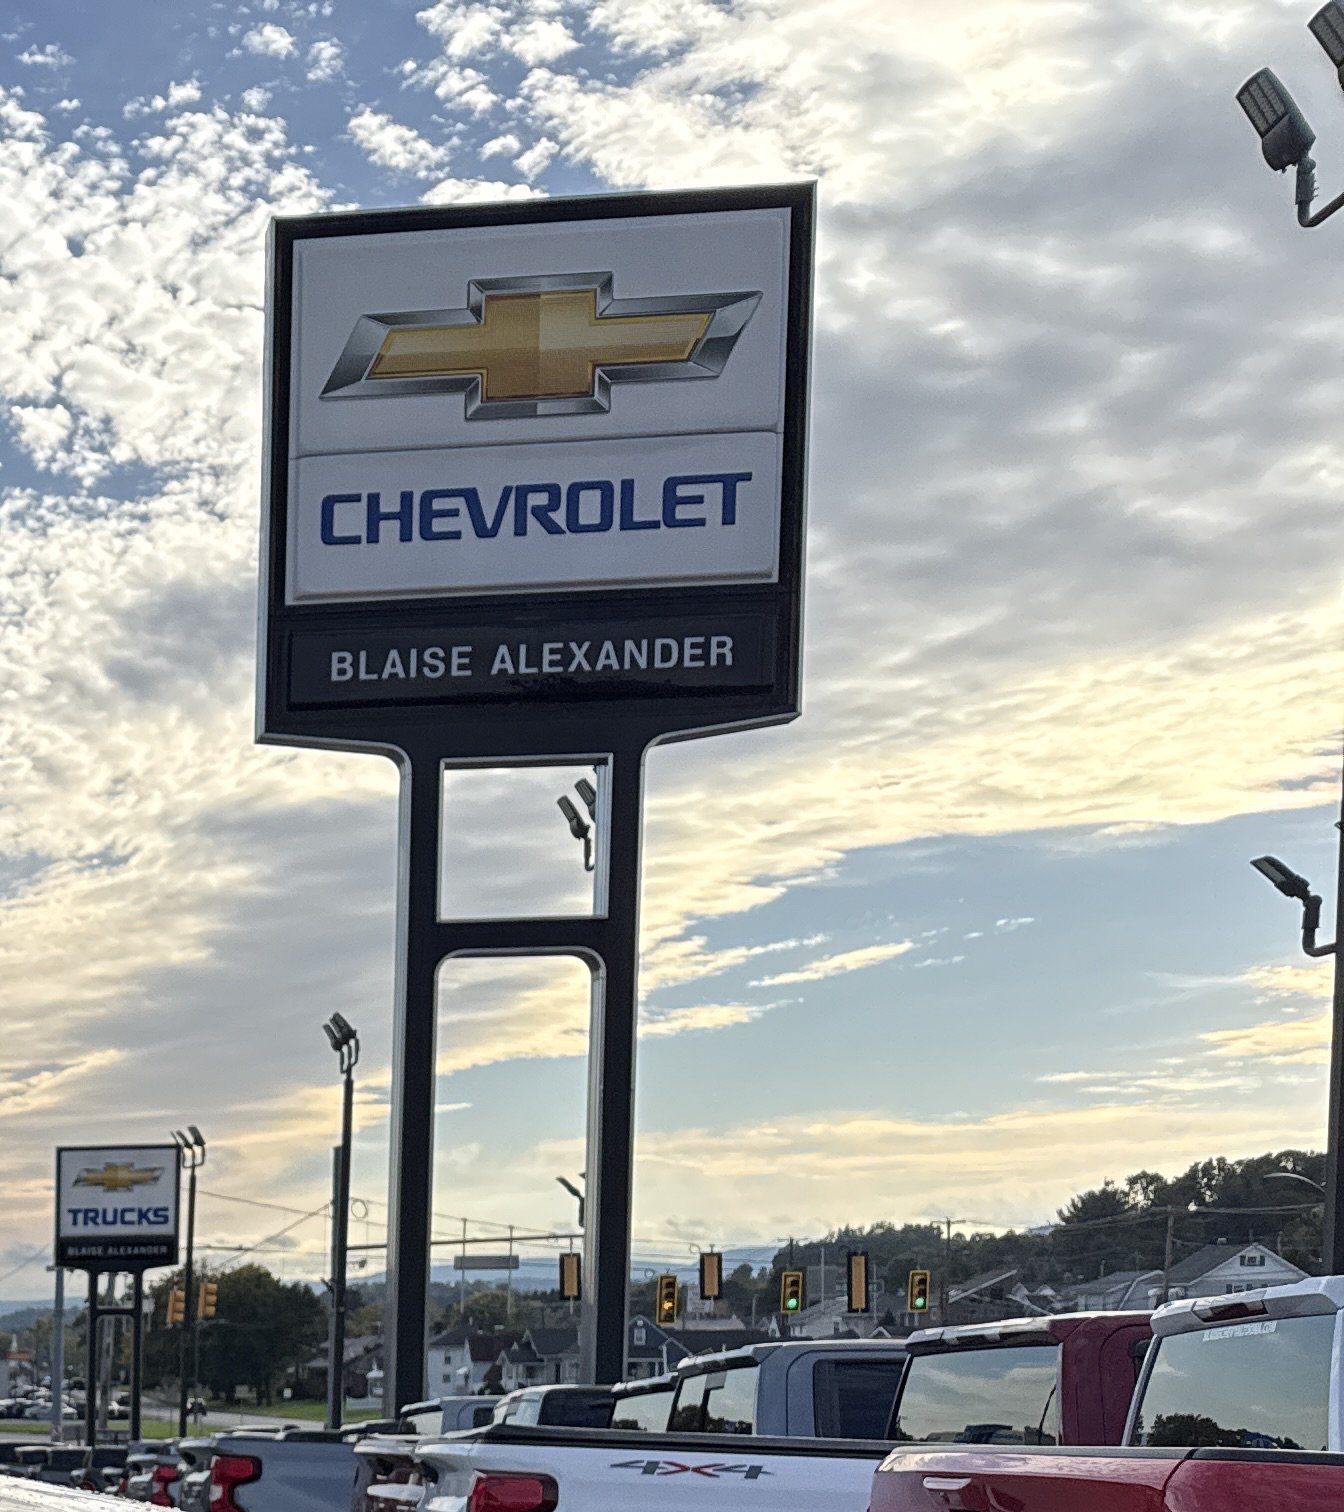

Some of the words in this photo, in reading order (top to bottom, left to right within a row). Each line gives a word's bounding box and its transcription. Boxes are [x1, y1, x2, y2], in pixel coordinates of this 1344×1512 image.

[320, 472, 753, 546] CHEVROLET
[330, 646, 472, 682] BLAISE
[490, 636, 734, 676] ALEXANDER
[67, 1206, 169, 1226] TRUCKS
[67, 1246, 103, 1256] BLAISE
[107, 1245, 167, 1255] ALEXANDER
